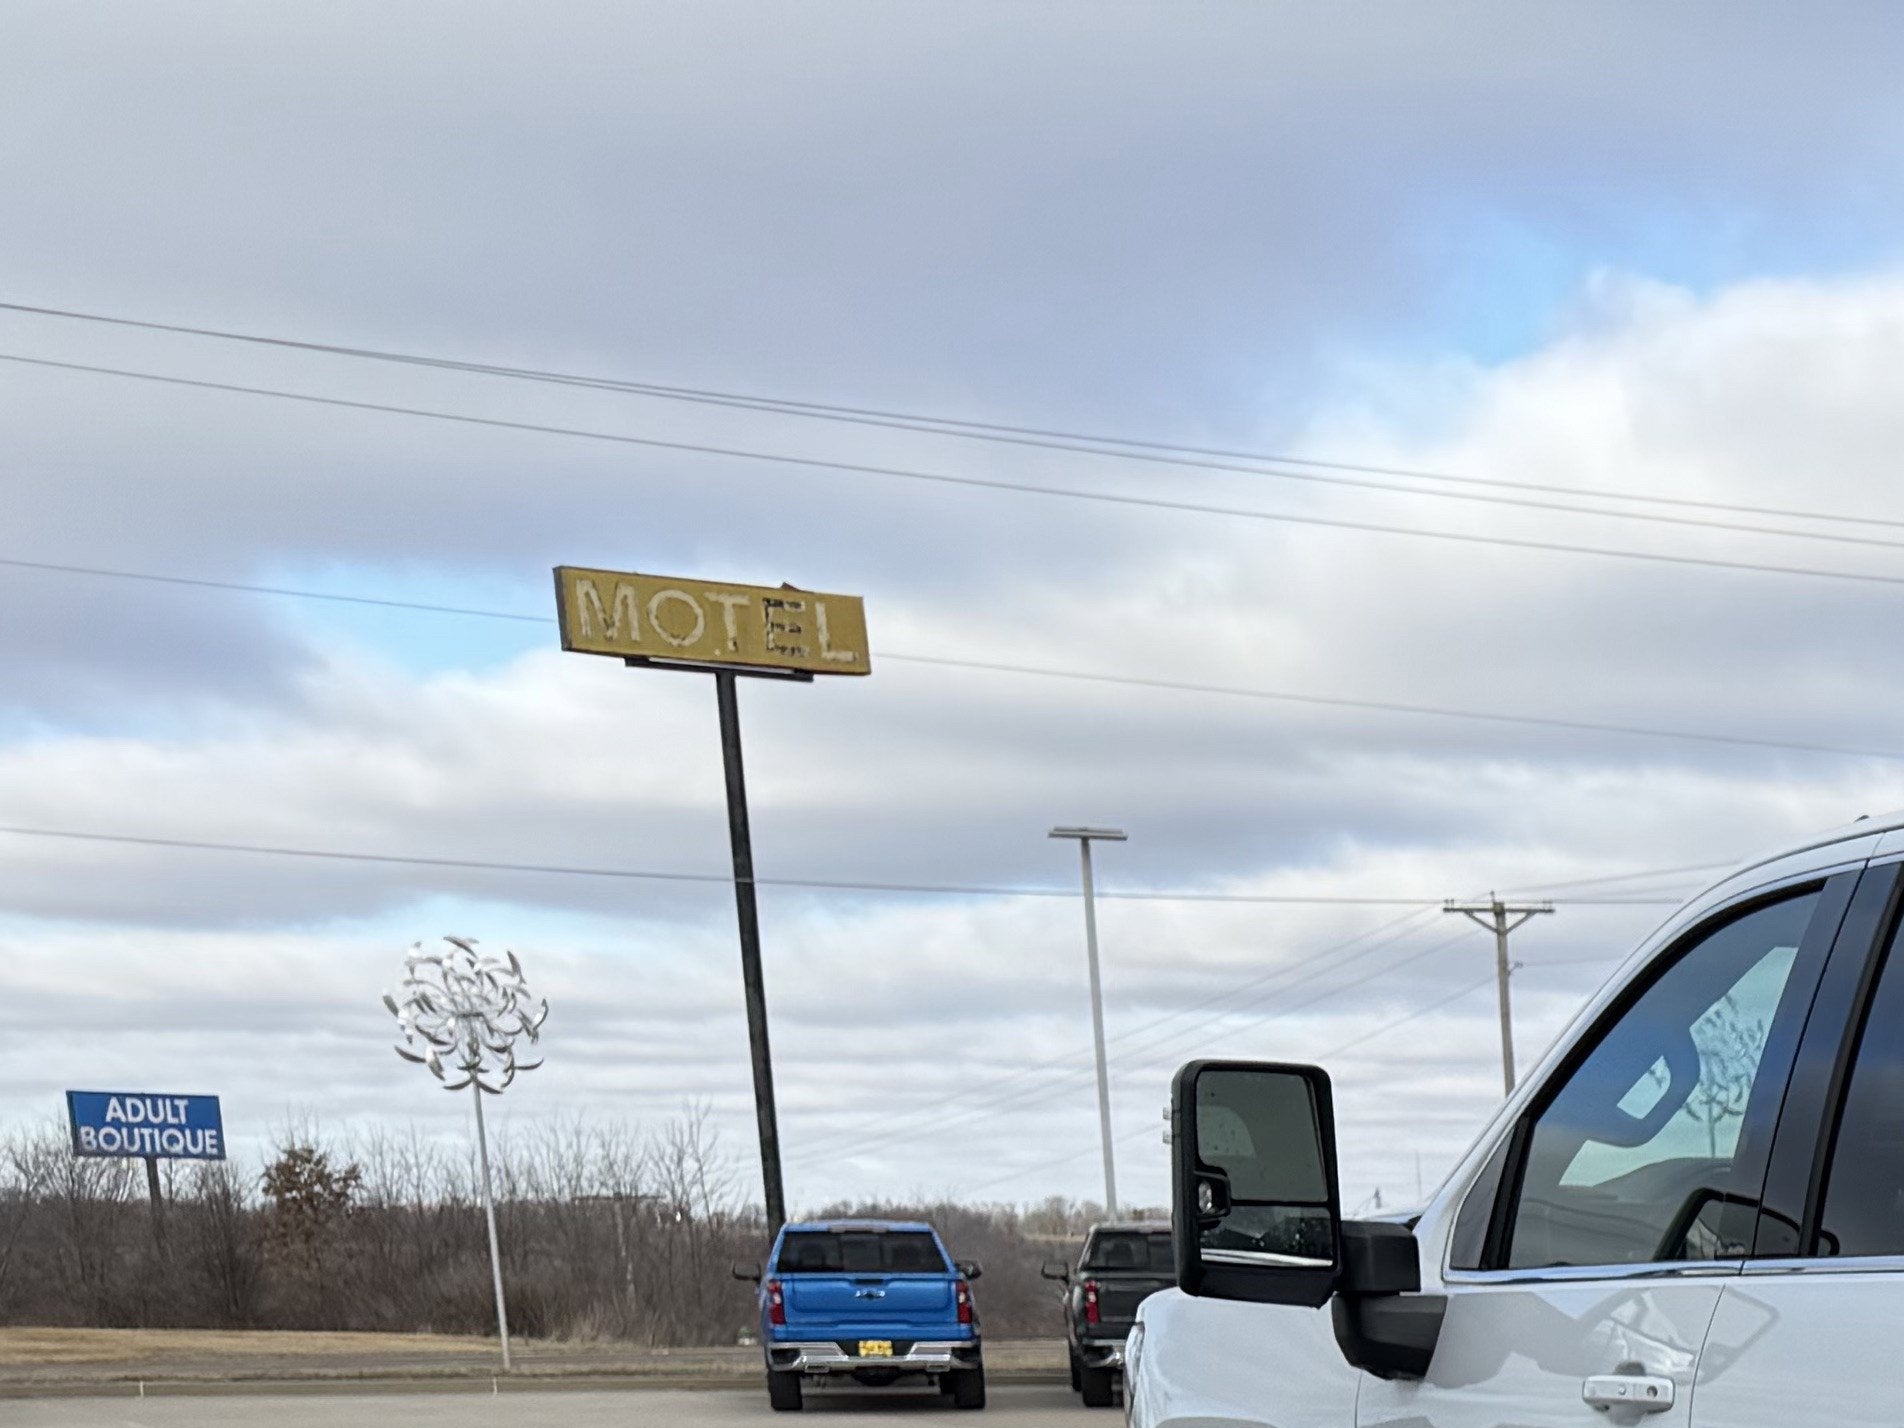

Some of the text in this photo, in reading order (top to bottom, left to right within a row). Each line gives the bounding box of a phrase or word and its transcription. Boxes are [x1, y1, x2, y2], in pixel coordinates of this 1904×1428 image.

[576, 579, 860, 663] MOTEL
[105, 1096, 189, 1125] ADULT
[79, 1125, 219, 1155] BOUTIQUE
